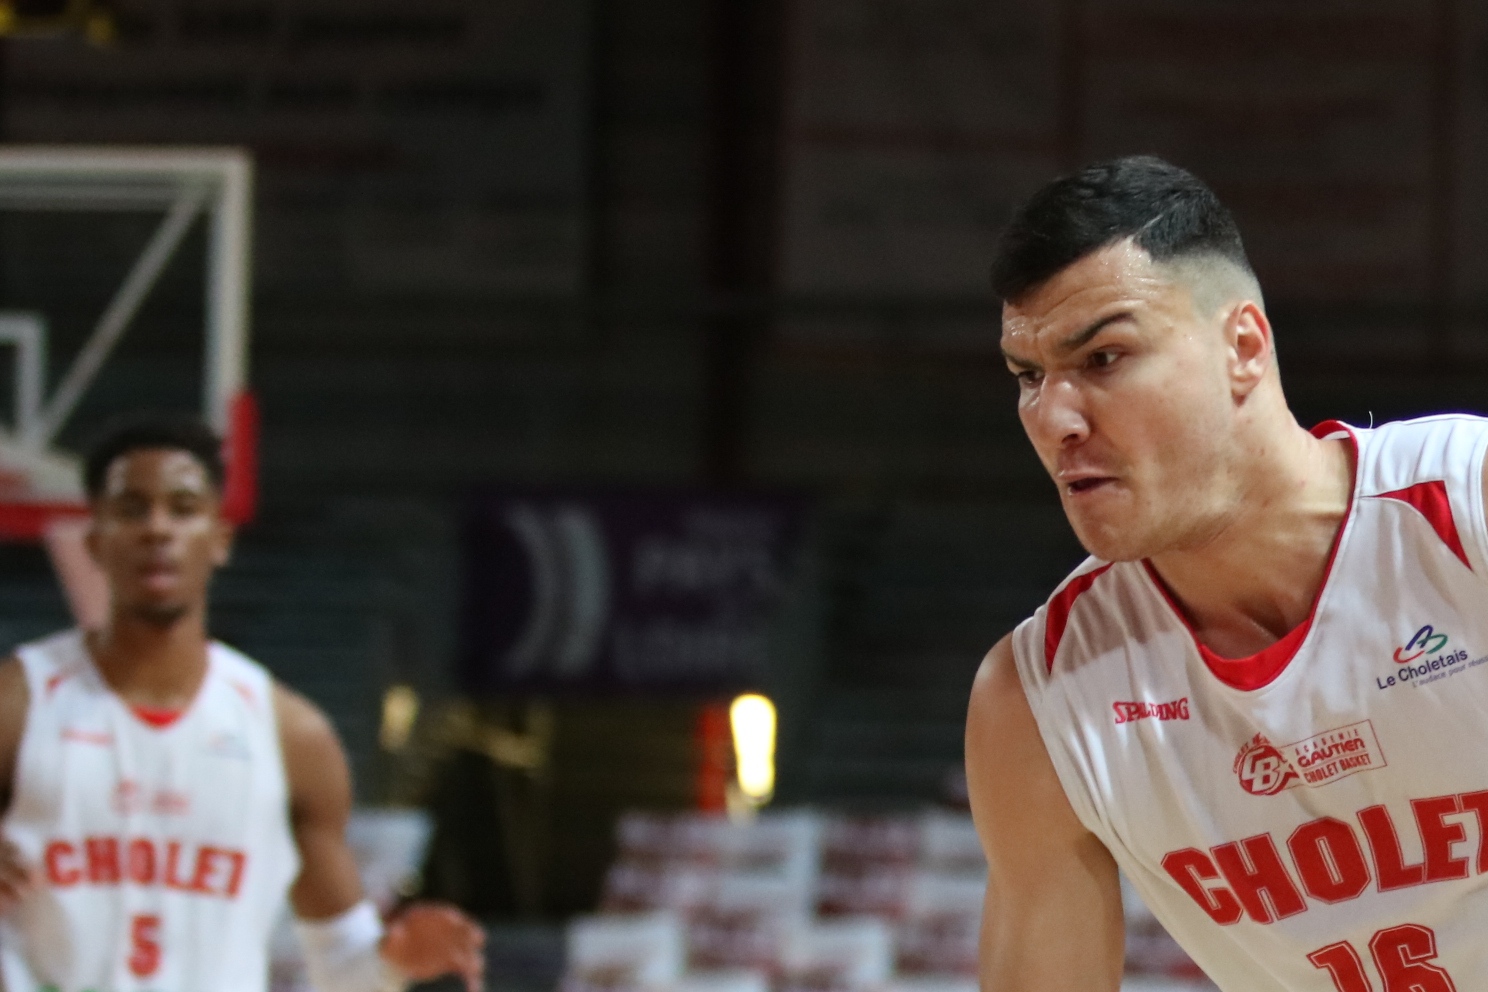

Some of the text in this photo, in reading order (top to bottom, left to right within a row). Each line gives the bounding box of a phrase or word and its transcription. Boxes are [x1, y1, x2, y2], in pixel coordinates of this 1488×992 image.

[1376, 649, 1469, 690] Le Choletais
[1298, 738, 1365, 767] GAUTIER
[1303, 753, 1371, 783] CHOLET BASKET
[44, 835, 247, 900] CHOLET
[128, 912, 163, 978] 5
